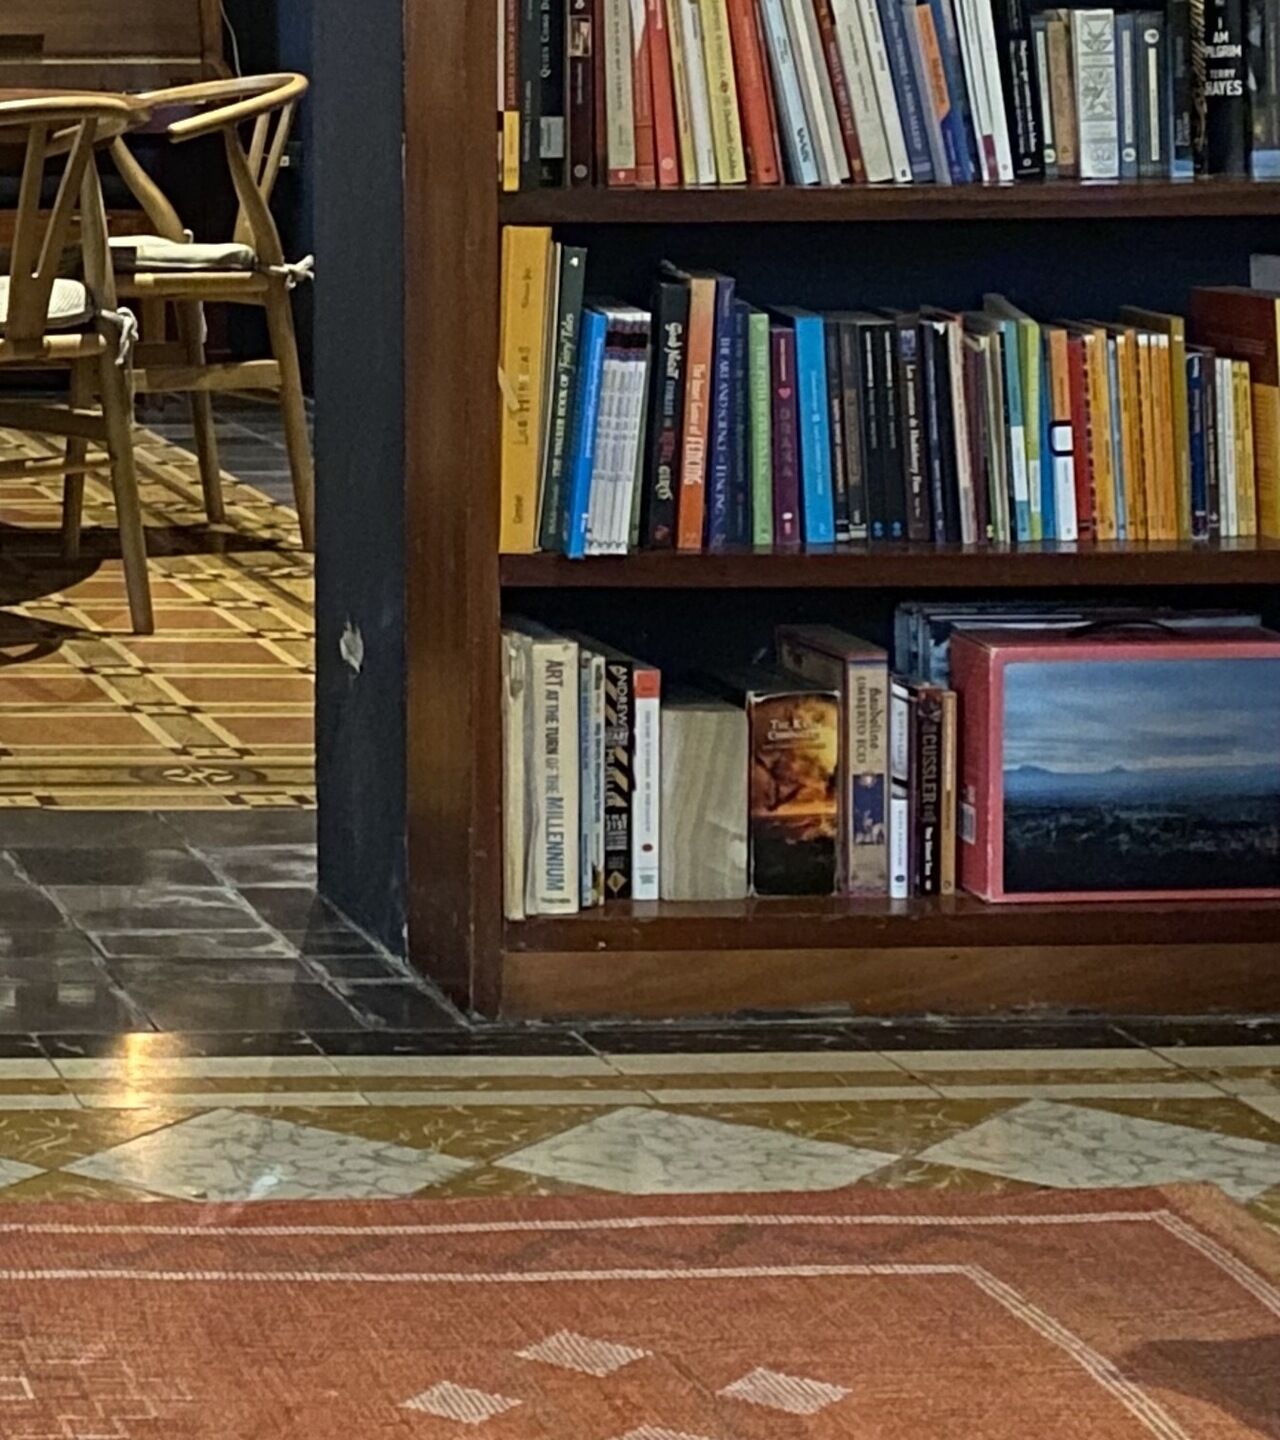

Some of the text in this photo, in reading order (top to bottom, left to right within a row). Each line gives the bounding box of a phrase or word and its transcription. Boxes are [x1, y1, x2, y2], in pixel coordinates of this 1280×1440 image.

[1217, 16, 1222, 29] I
[1213, 31, 1228, 43] AM
[1205, 44, 1242, 58] PILGRIM
[1209, 69, 1235, 79] TERRY
[1204, 80, 1243, 97] HAYES
[559, 342, 574, 375] Fairy
[695, 363, 706, 378] The
[694, 379, 705, 401] Inner
[692, 402, 703, 424] Game
[685, 436, 704, 486] FENCING
[657, 465, 673, 500] GIRLS
[714, 464, 727, 515] FENCING
[856, 676, 868, 764] UMBERTO ECO
[606, 665, 628, 808] ANDREW MUELLER
[545, 659, 565, 891] ART AT THE TURN OF THE MILLENNIUM
[922, 735, 937, 803] CUSSLER
